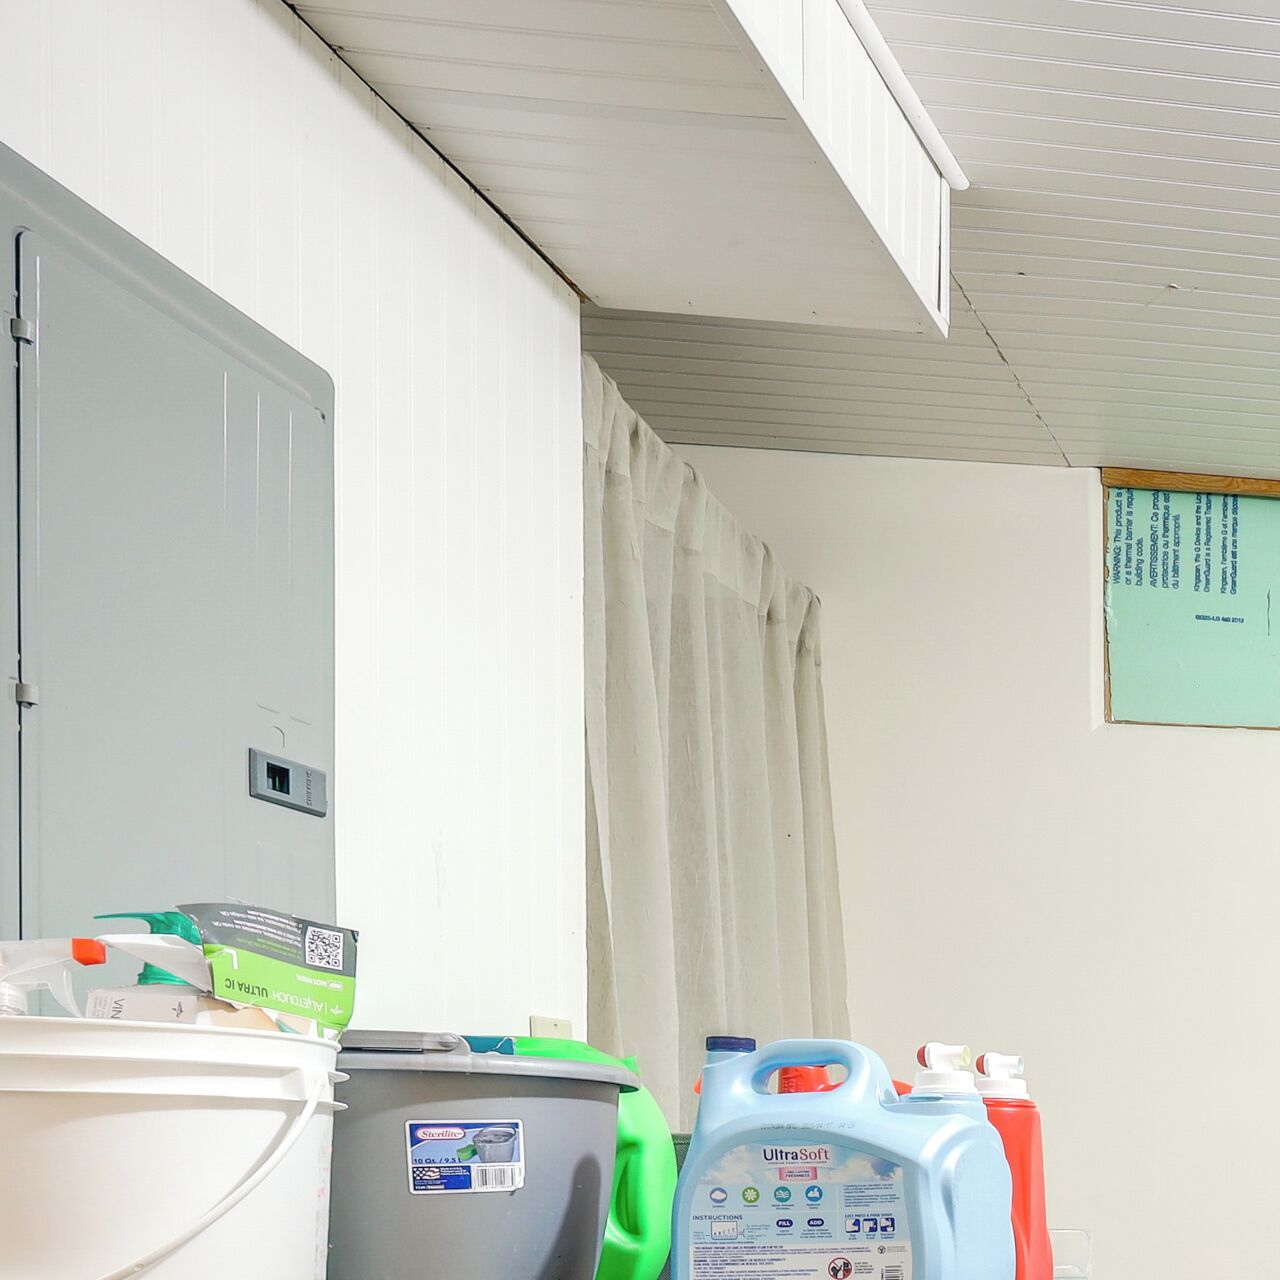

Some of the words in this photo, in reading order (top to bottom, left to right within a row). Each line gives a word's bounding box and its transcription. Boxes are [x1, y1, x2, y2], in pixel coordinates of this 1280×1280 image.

[1115, 499, 1123, 527] product
[1125, 518, 1133, 541] barrier
[1124, 542, 1133, 569] thermal
[1136, 536, 1144, 557] code.
[1135, 558, 1144, 586] building
[237, 982, 269, 998] ULTRA
